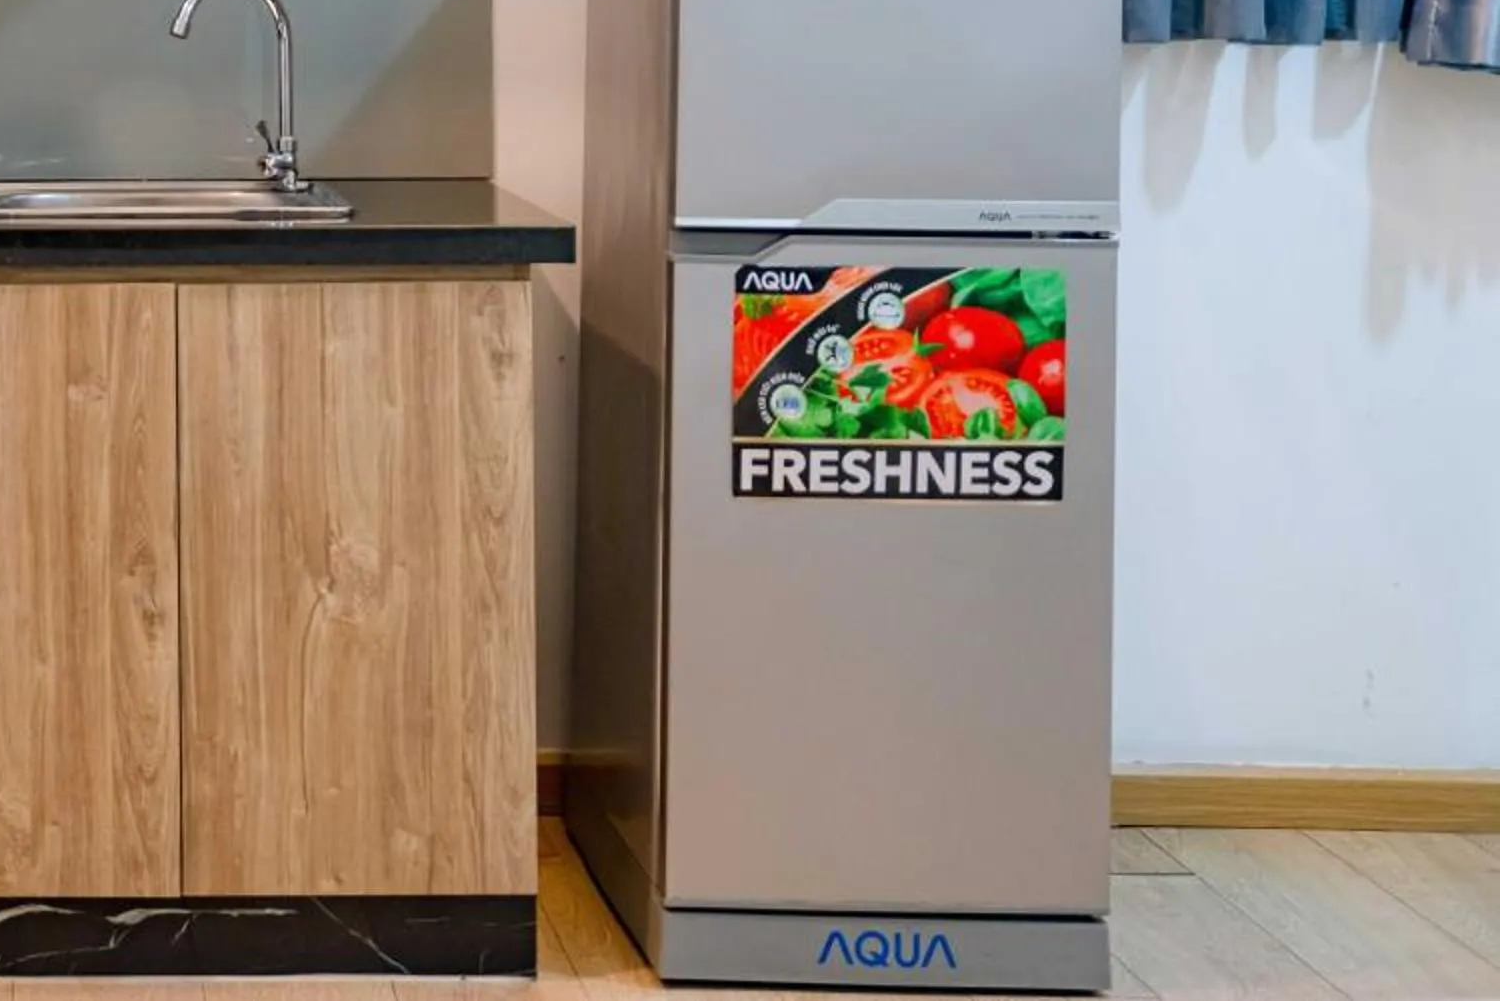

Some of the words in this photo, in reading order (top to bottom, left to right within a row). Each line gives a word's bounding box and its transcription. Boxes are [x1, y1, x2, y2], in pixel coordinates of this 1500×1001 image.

[743, 270, 814, 291] AQUA
[739, 448, 1055, 496] FRESHNESS
[817, 930, 957, 969] AQUA
